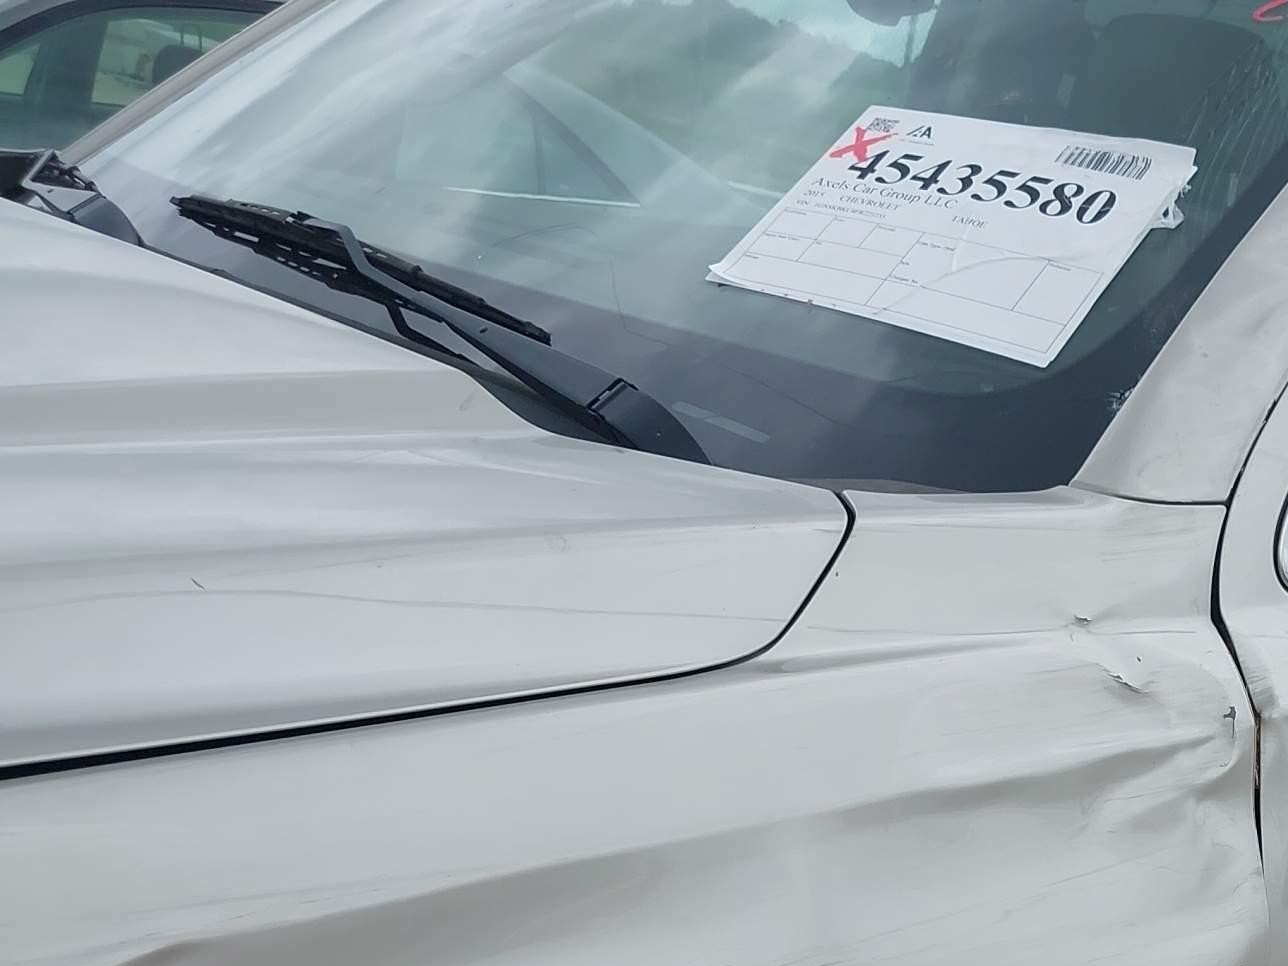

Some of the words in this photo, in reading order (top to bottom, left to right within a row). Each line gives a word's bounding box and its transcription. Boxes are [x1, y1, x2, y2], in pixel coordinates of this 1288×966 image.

[811, 178, 850, 191] Axels
[853, 182, 879, 194] Car
[881, 187, 921, 203] Group
[924, 195, 959, 209] LLC
[848, 149, 1117, 225] 45435580
[839, 195, 901, 211] CHEVROLET
[952, 215, 989, 229] TAHOE
